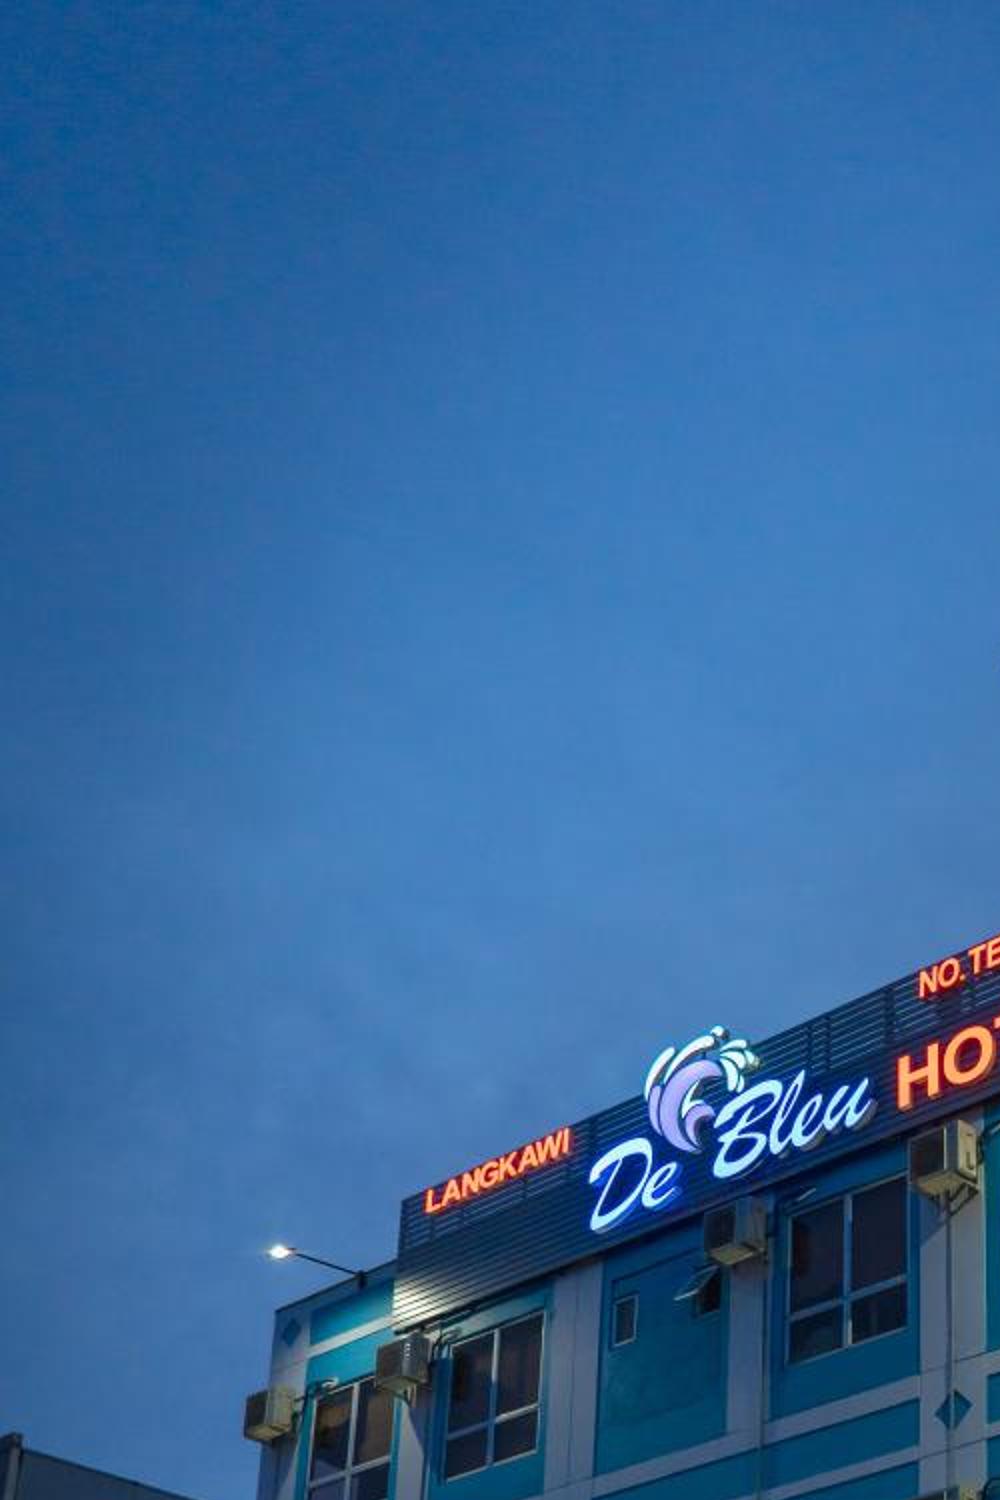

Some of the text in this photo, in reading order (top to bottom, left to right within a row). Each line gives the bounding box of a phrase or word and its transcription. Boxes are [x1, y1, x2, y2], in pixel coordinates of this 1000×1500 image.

[423, 1127, 572, 1214] LANGKAWI
[588, 1137, 677, 1232] De
[713, 1070, 871, 1178] Bleu
